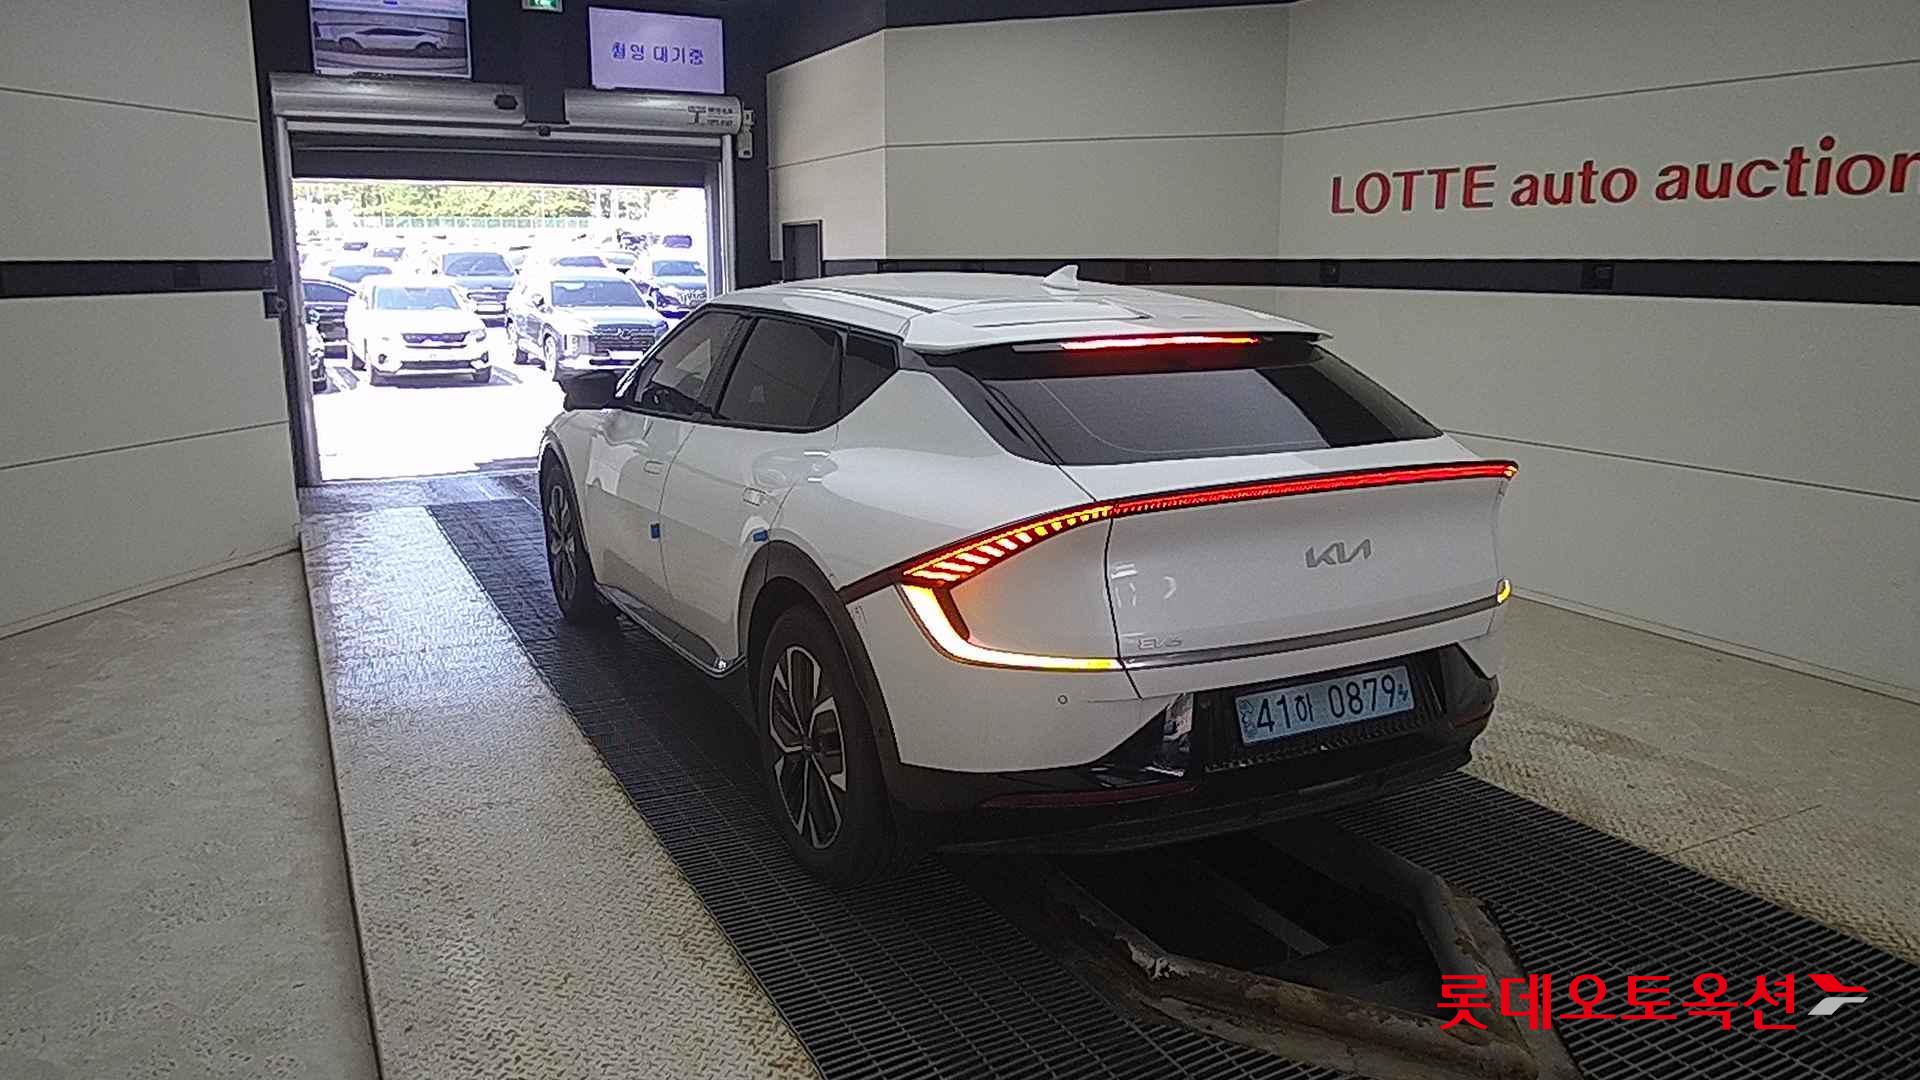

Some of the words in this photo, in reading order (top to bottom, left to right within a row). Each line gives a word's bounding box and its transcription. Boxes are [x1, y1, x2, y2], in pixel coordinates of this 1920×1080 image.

[1330, 163, 1497, 214] LOTTE
[1511, 160, 1638, 206] auto
[1305, 538, 1372, 568] KIA
[1256, 692, 1314, 732] 41하
[1327, 674, 1396, 718] 0879
